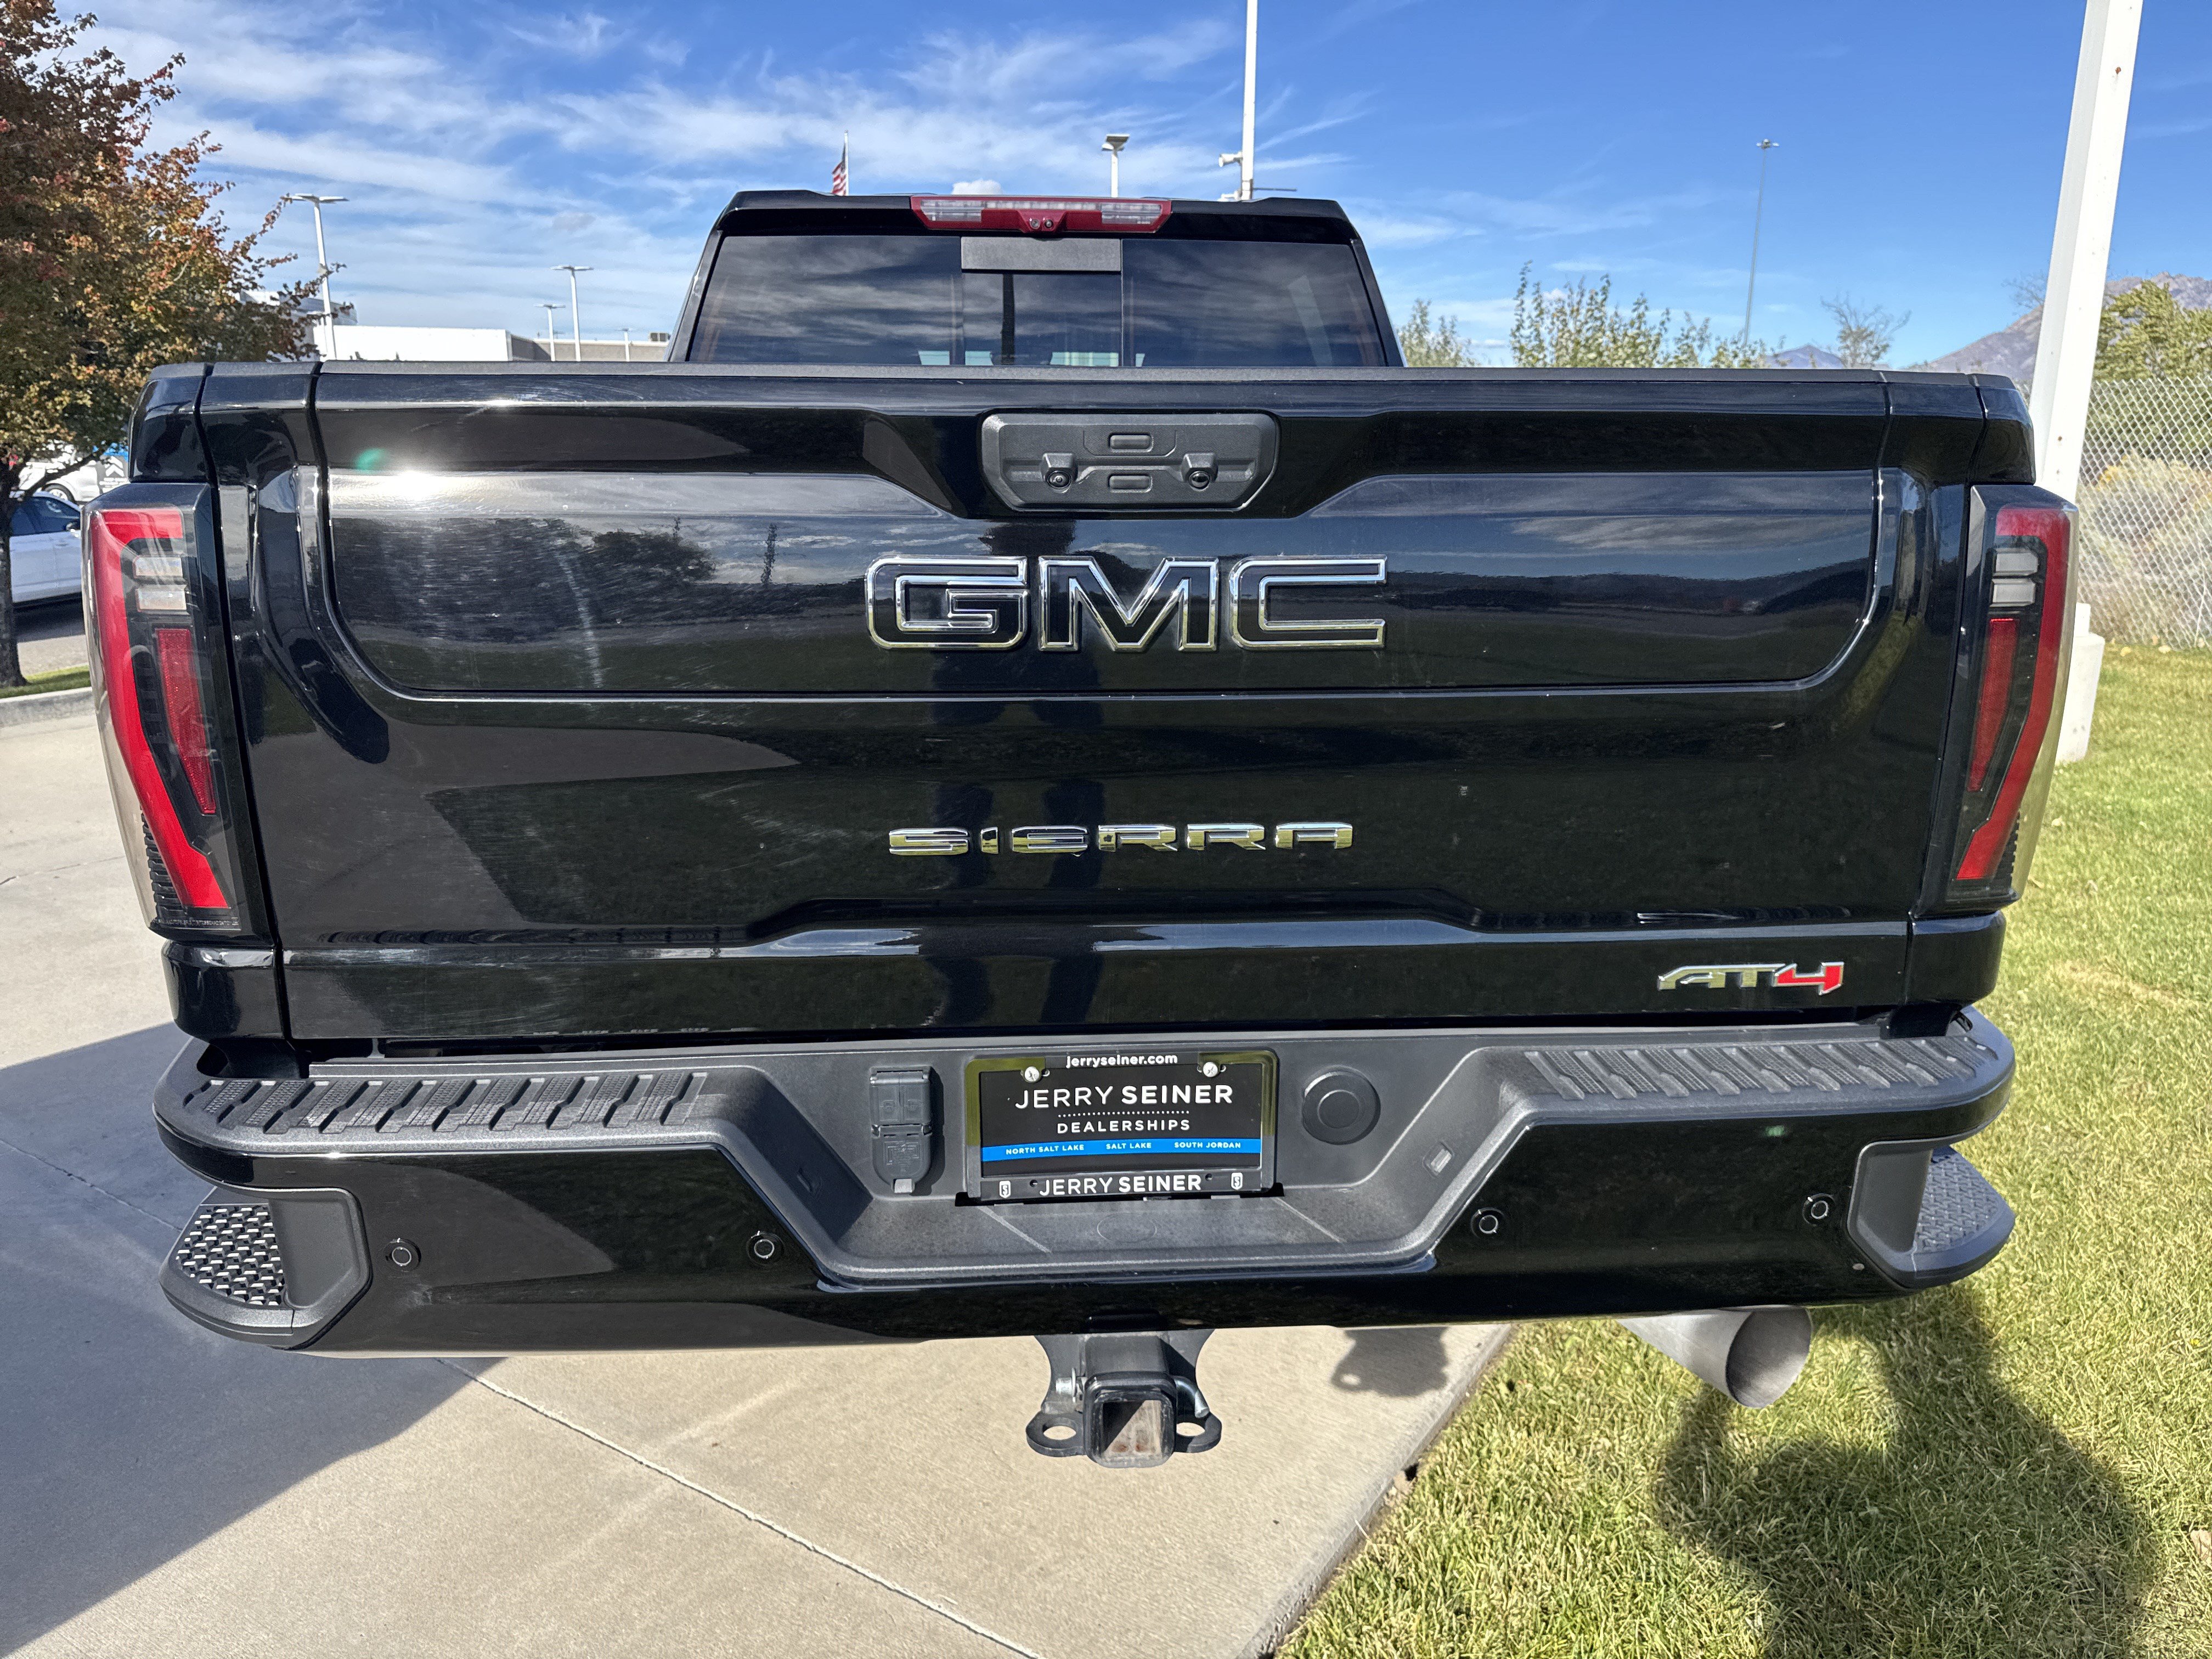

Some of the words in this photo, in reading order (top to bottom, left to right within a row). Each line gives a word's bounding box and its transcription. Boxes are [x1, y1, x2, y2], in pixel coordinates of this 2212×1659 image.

[864, 555, 1388, 652] GMC
[888, 822, 1353, 856] SIERRA
[1658, 961, 1844, 995] AT4
[1065, 1053, 1178, 1068] jerryseiner.com
[1015, 1086, 1113, 1109] JERRY
[1121, 1085, 1233, 1105] SEINER
[1057, 1119, 1190, 1134] DEALERSHIPS
[1039, 1177, 1113, 1196] JERRY
[1118, 1175, 1201, 1193] SEINER
